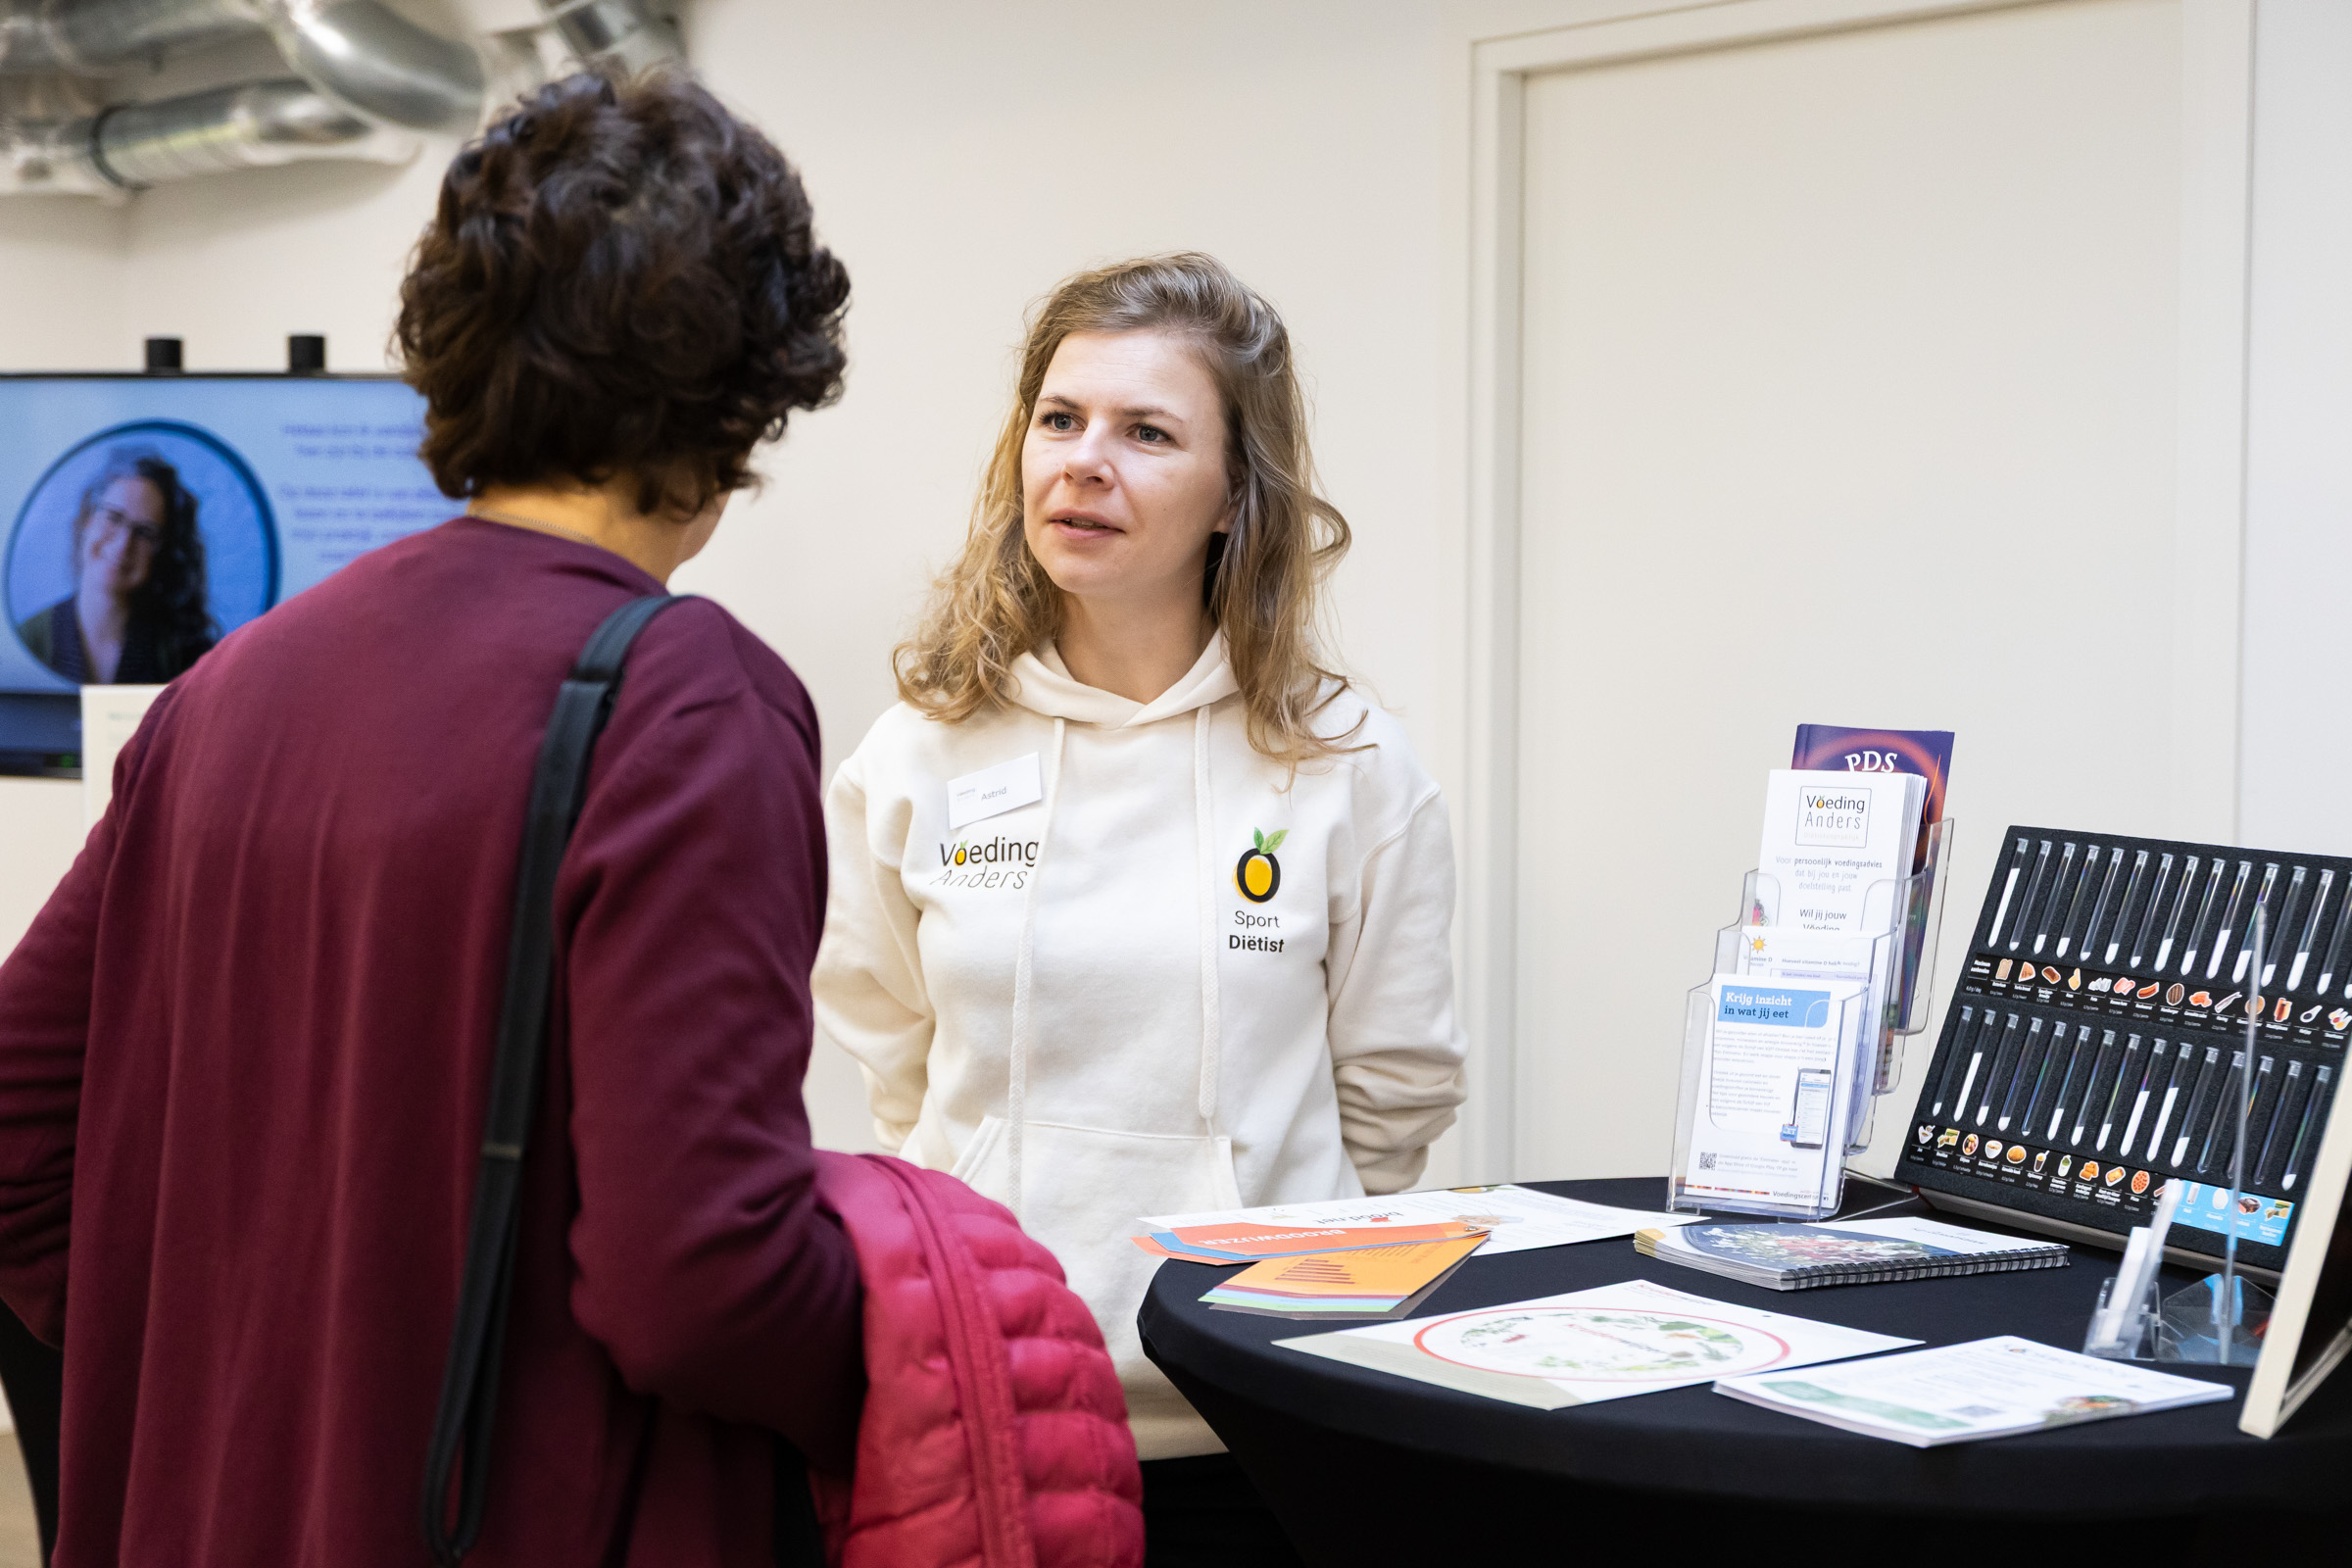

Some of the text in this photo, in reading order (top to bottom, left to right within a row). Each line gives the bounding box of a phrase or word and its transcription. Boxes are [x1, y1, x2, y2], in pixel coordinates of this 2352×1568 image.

[1844, 751, 1897, 773] PDS
[981, 786, 1007, 802] Astrid
[1804, 811, 1862, 830] Anders
[1776, 856, 1883, 870] Voor persoonlijk voedingsadvies
[929, 865, 1028, 890] Anders
[1807, 870, 1816, 880] bij
[1818, 871, 1830, 880] jou
[1841, 872, 1858, 881] jouw
[1798, 882, 1836, 894] doelstelling
[1234, 909, 1280, 929] Sport
[1799, 908, 1847, 920] Wil jij jouw
[1229, 934, 1285, 953] Diëtist
[1726, 992, 1792, 1006] Krijg inzicht
[1725, 1005, 1789, 1019] in wat jij eet
[1198, 1228, 1348, 1246] BROODWIJZER
